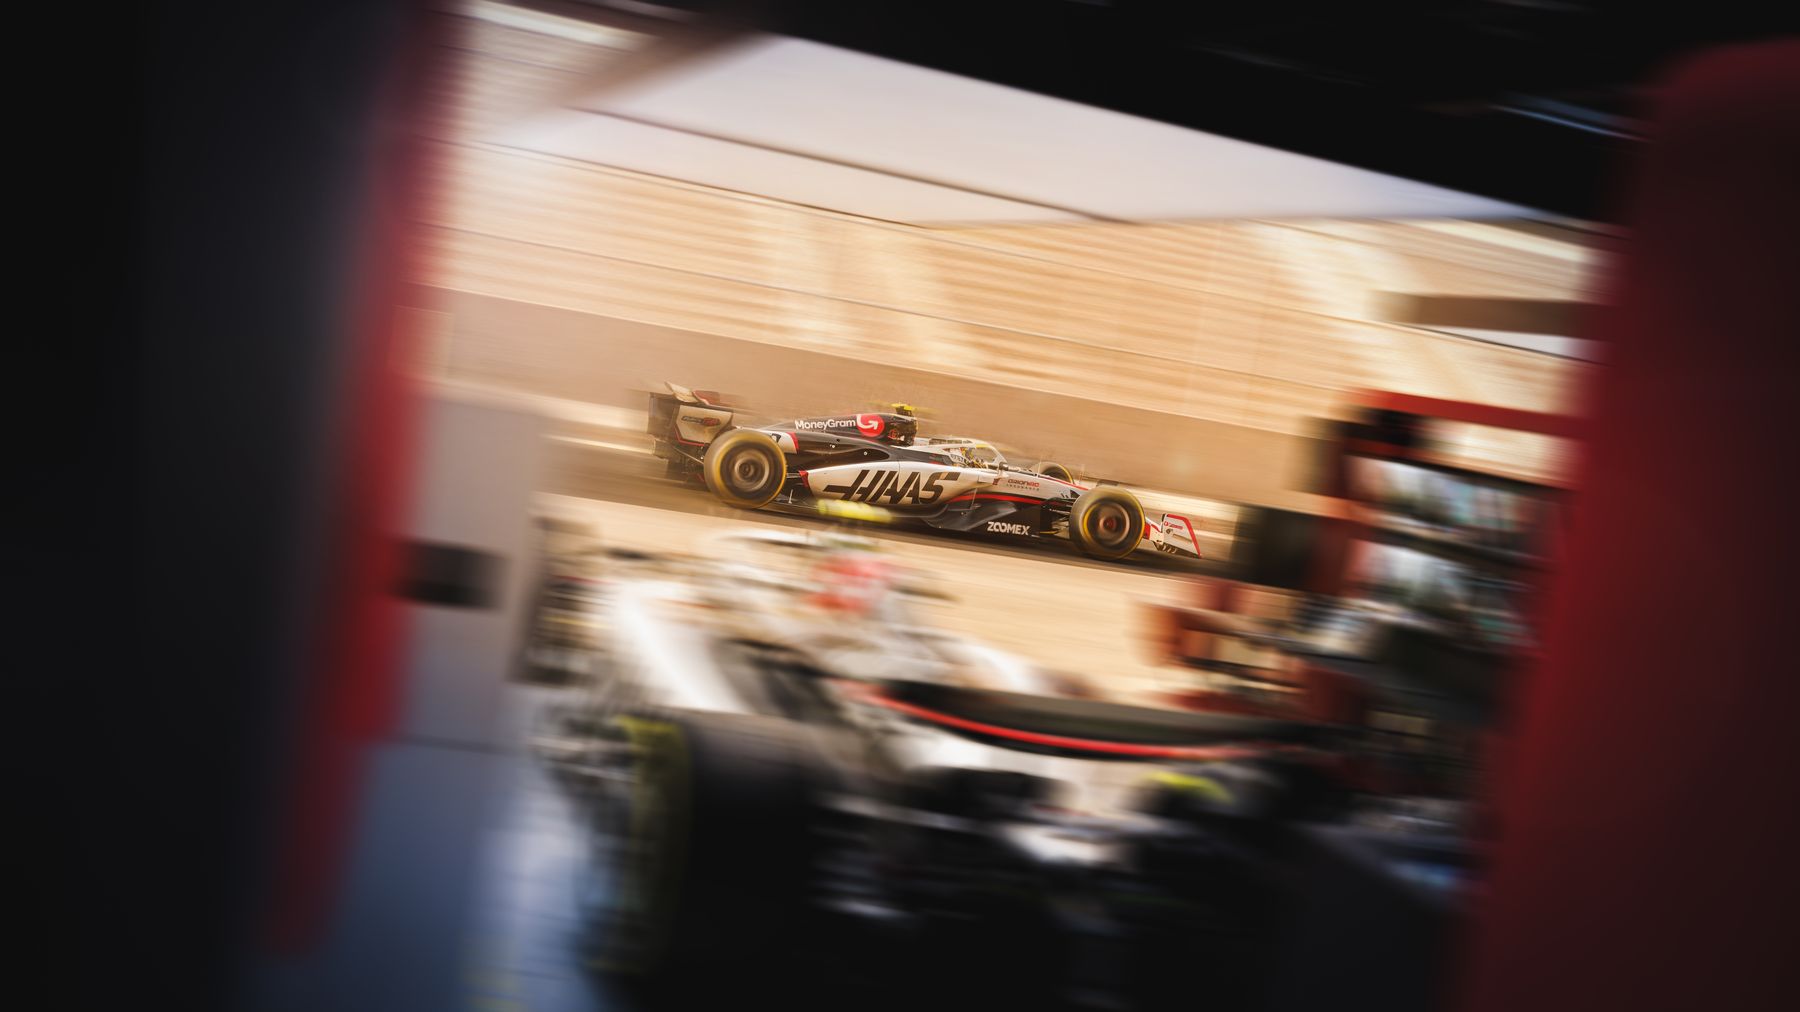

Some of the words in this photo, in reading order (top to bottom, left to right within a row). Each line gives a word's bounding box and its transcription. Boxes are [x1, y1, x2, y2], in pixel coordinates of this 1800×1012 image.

[794, 418, 856, 430] MoneyGram
[823, 470, 962, 505] HAAS
[987, 521, 1031, 536] ZOOMEX
